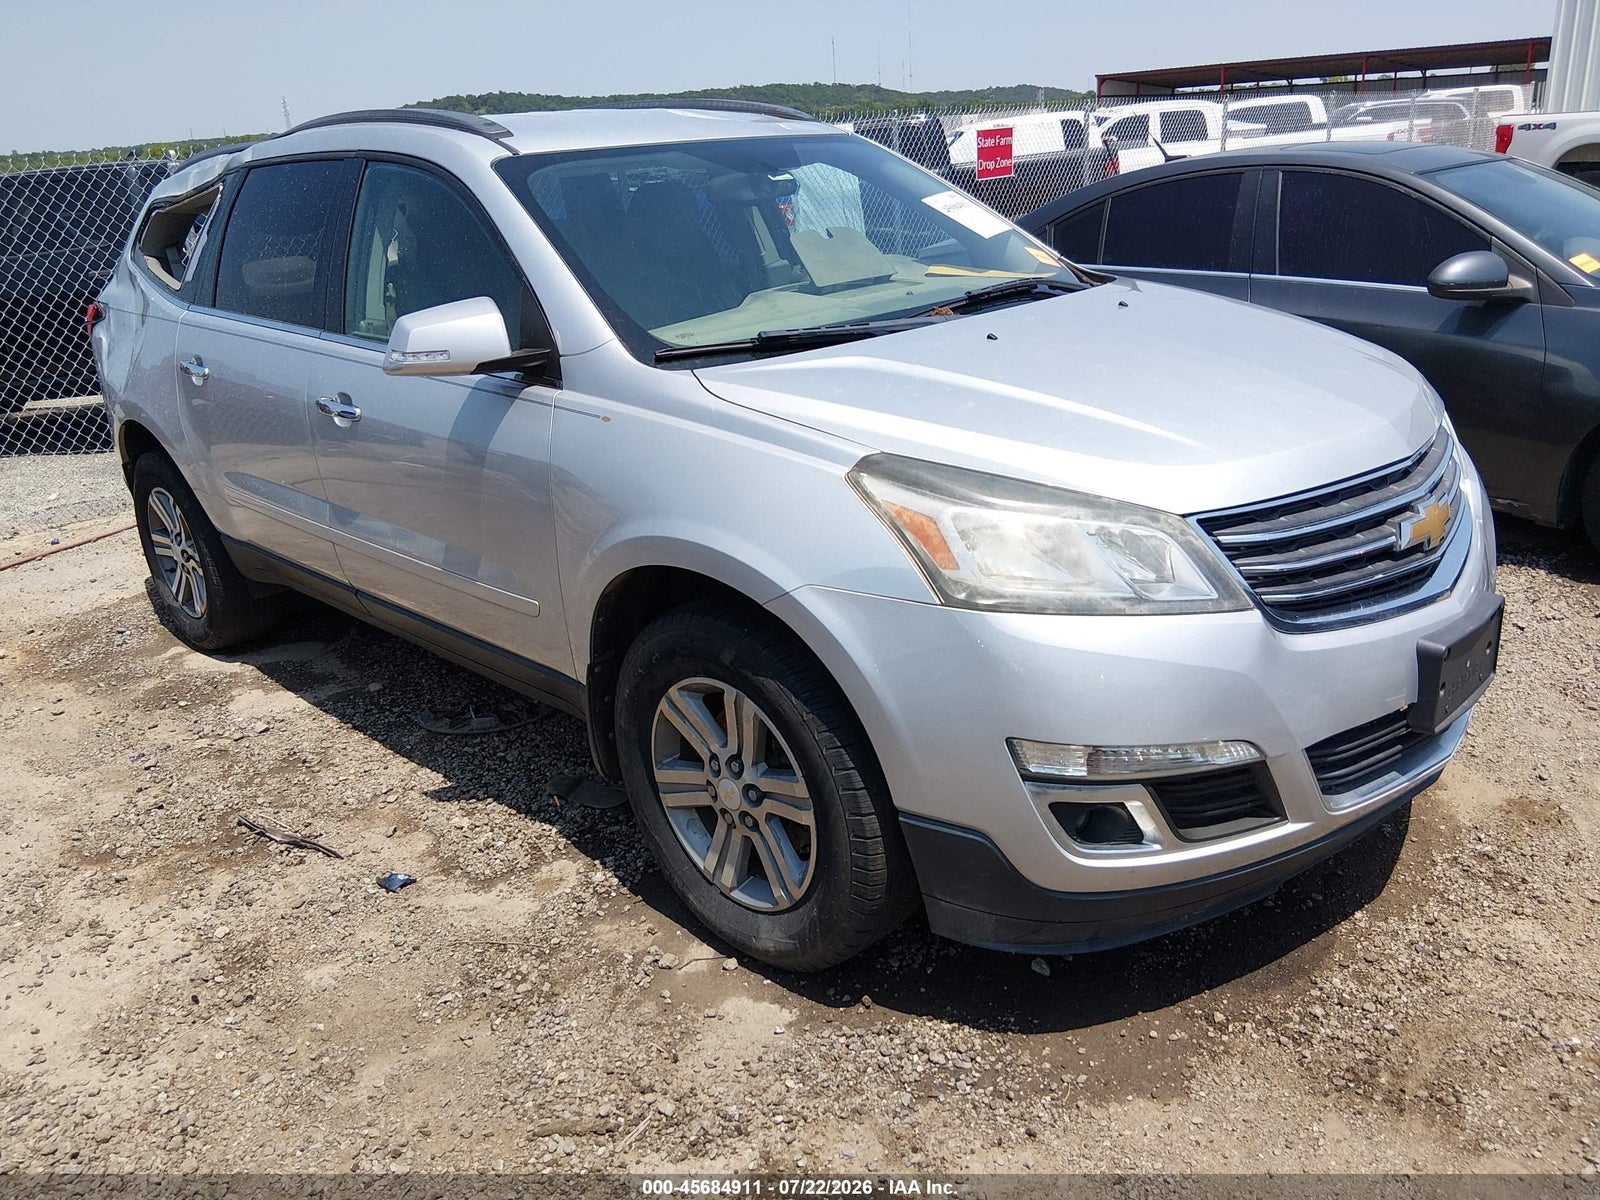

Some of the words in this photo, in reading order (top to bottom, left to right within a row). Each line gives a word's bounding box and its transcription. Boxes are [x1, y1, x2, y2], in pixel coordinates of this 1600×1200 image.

[977, 137, 995, 148] State
[995, 135, 1012, 146] Farm
[978, 160, 995, 171] Drop
[995, 157, 1012, 169] Zone
